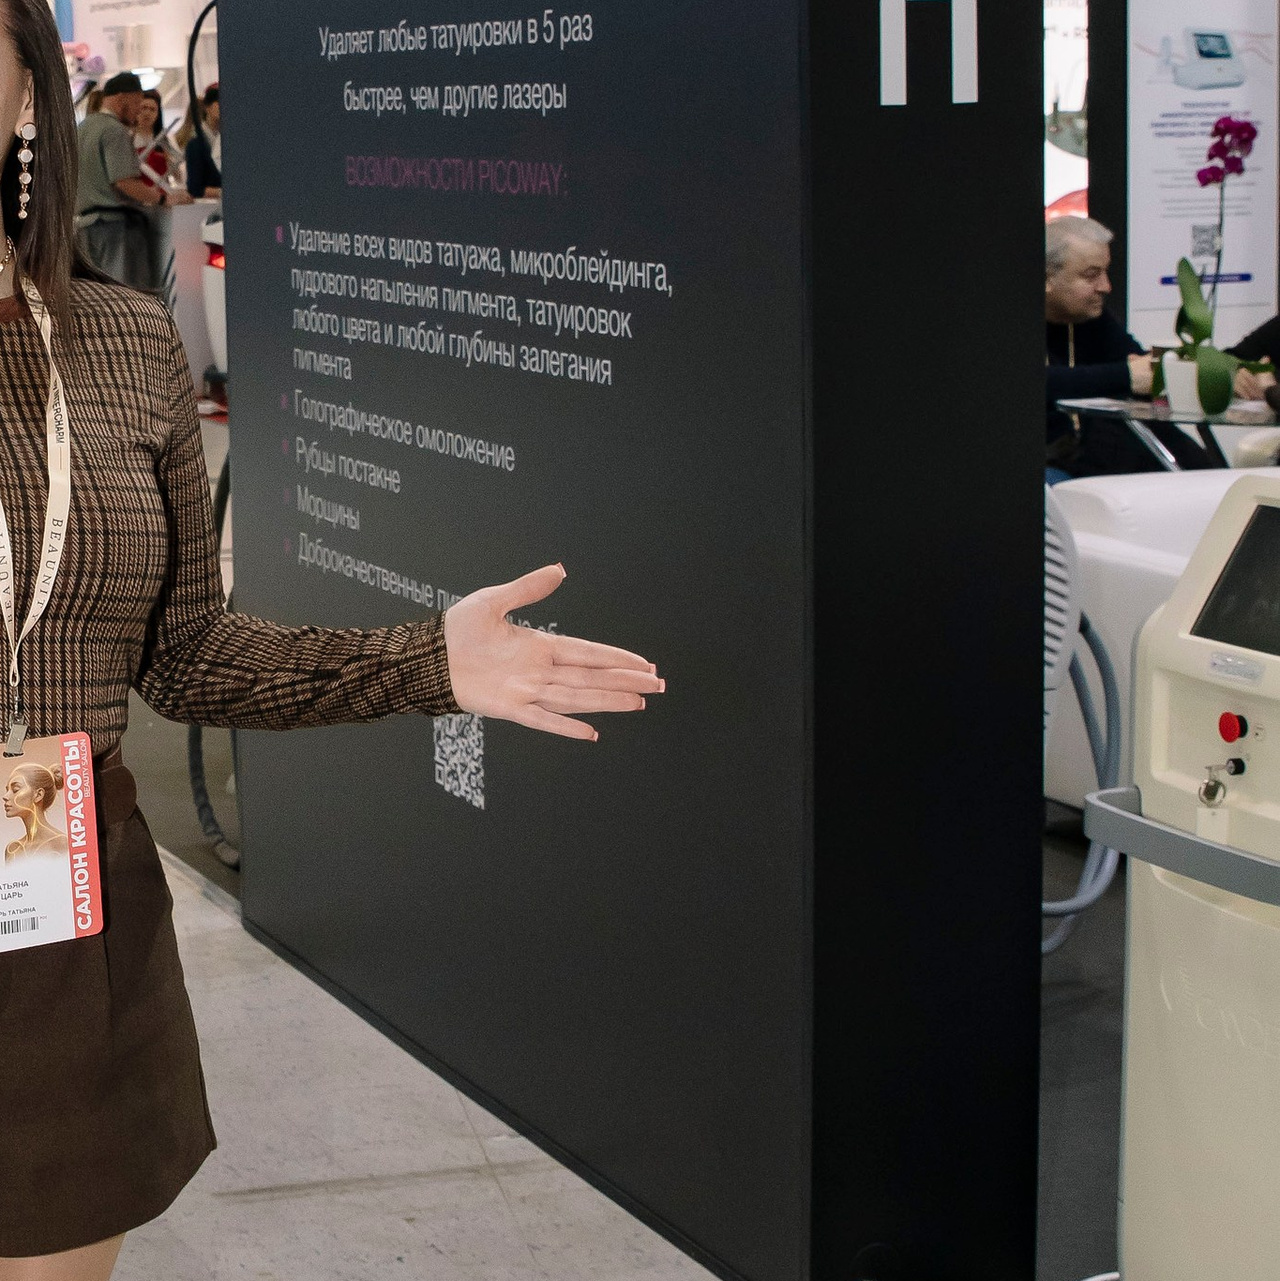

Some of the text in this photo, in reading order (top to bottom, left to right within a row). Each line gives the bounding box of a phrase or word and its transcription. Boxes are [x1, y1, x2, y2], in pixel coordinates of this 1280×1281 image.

[318, 9, 593, 61] Удаляет любые татуировки в 5 раз
[343, 80, 567, 118] быстрее, чем другие лазеры
[345, 155, 568, 196] ВОЗМОЖНОСТИ PICOWAY:
[289, 221, 673, 298] Удаление всех видов татуажа, микроблейдинга,
[291, 268, 633, 340] пудрового напыления пигмента, татуировок
[292, 304, 612, 386] любого цвета и любой глубины залегания
[293, 347, 352, 381] пигмента
[294, 388, 516, 472] Голографическое омоложение
[295, 436, 401, 494] Рубцы постакне
[296, 484, 360, 530] Морщины
[30, 517, 64, 621] BEAUNITY
[297, 532, 434, 609] Доброкачественные
[79, 738, 91, 798] BEAUTY SALON
[63, 739, 93, 930] САЛОН КРАСОТЫ
[0, 891, 23, 901] ЦАРЬ
[7, 906, 36, 916] ТАТЬЯНА
